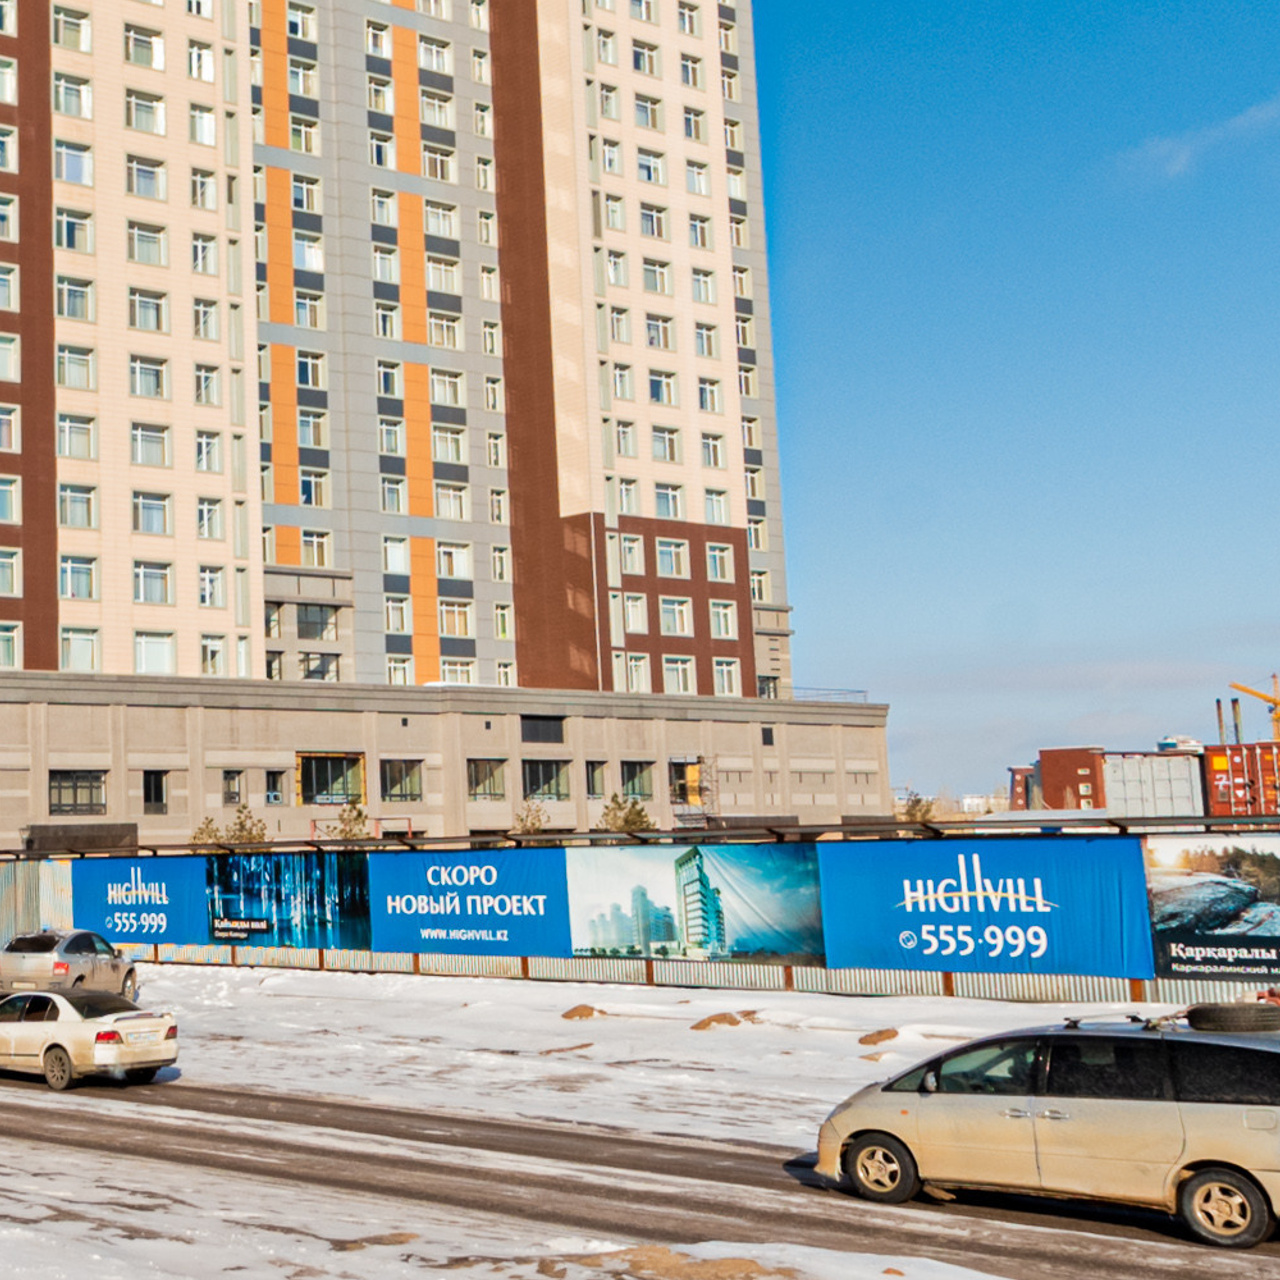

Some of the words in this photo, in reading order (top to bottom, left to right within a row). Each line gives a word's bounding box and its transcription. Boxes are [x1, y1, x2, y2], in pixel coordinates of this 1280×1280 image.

[107, 867, 169, 905] HIGHVILL
[427, 865, 498, 886] СКОРО
[903, 853, 1051, 913] HIGHVILL
[387, 892, 461, 915] НОВЫЙ
[466, 895, 547, 916] ПРОЕКТ
[420, 928, 509, 941] WWW.HIGHVILL.KZ
